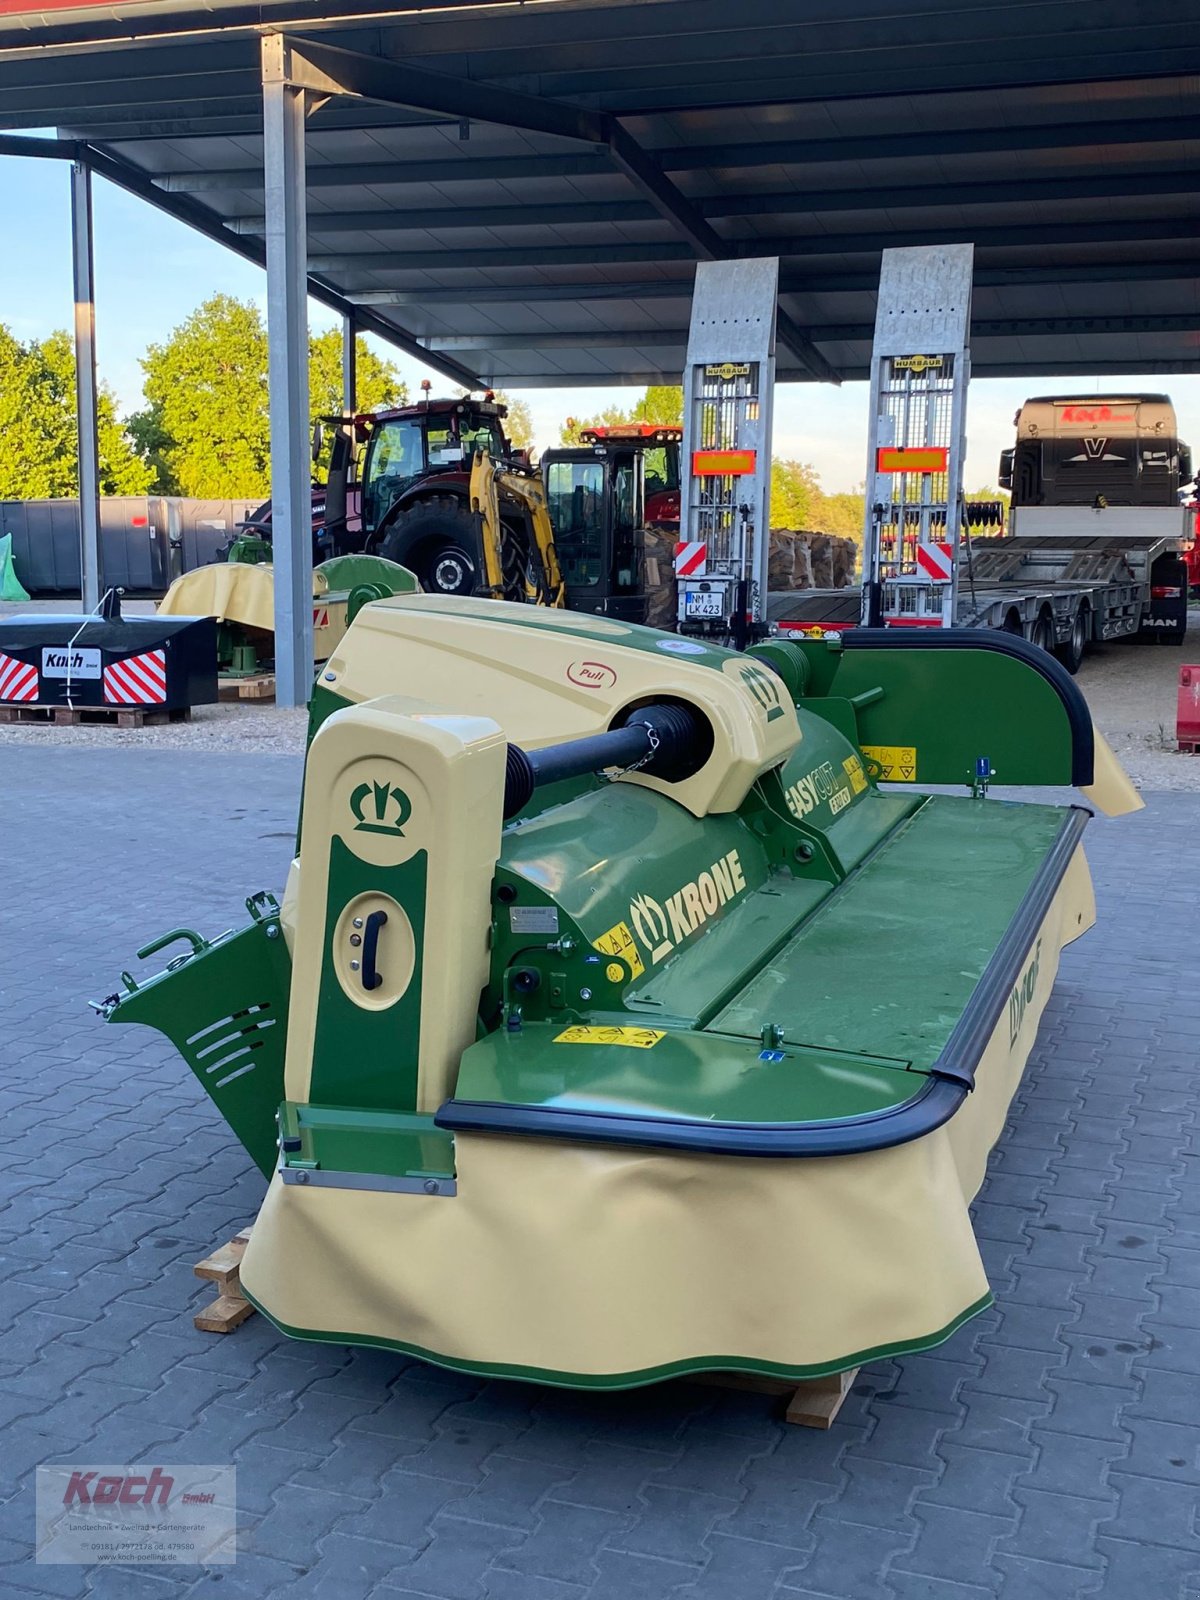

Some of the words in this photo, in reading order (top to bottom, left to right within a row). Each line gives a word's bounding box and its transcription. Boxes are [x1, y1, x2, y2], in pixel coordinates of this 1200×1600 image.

[895, 358, 941, 367] HUMBAUR
[1061, 405, 1112, 423] Koch
[689, 604, 701, 614] LK
[703, 604, 720, 615] 423
[1142, 618, 1178, 627] MAN
[579, 668, 605, 681] Pull
[664, 848, 747, 945] KRONE
